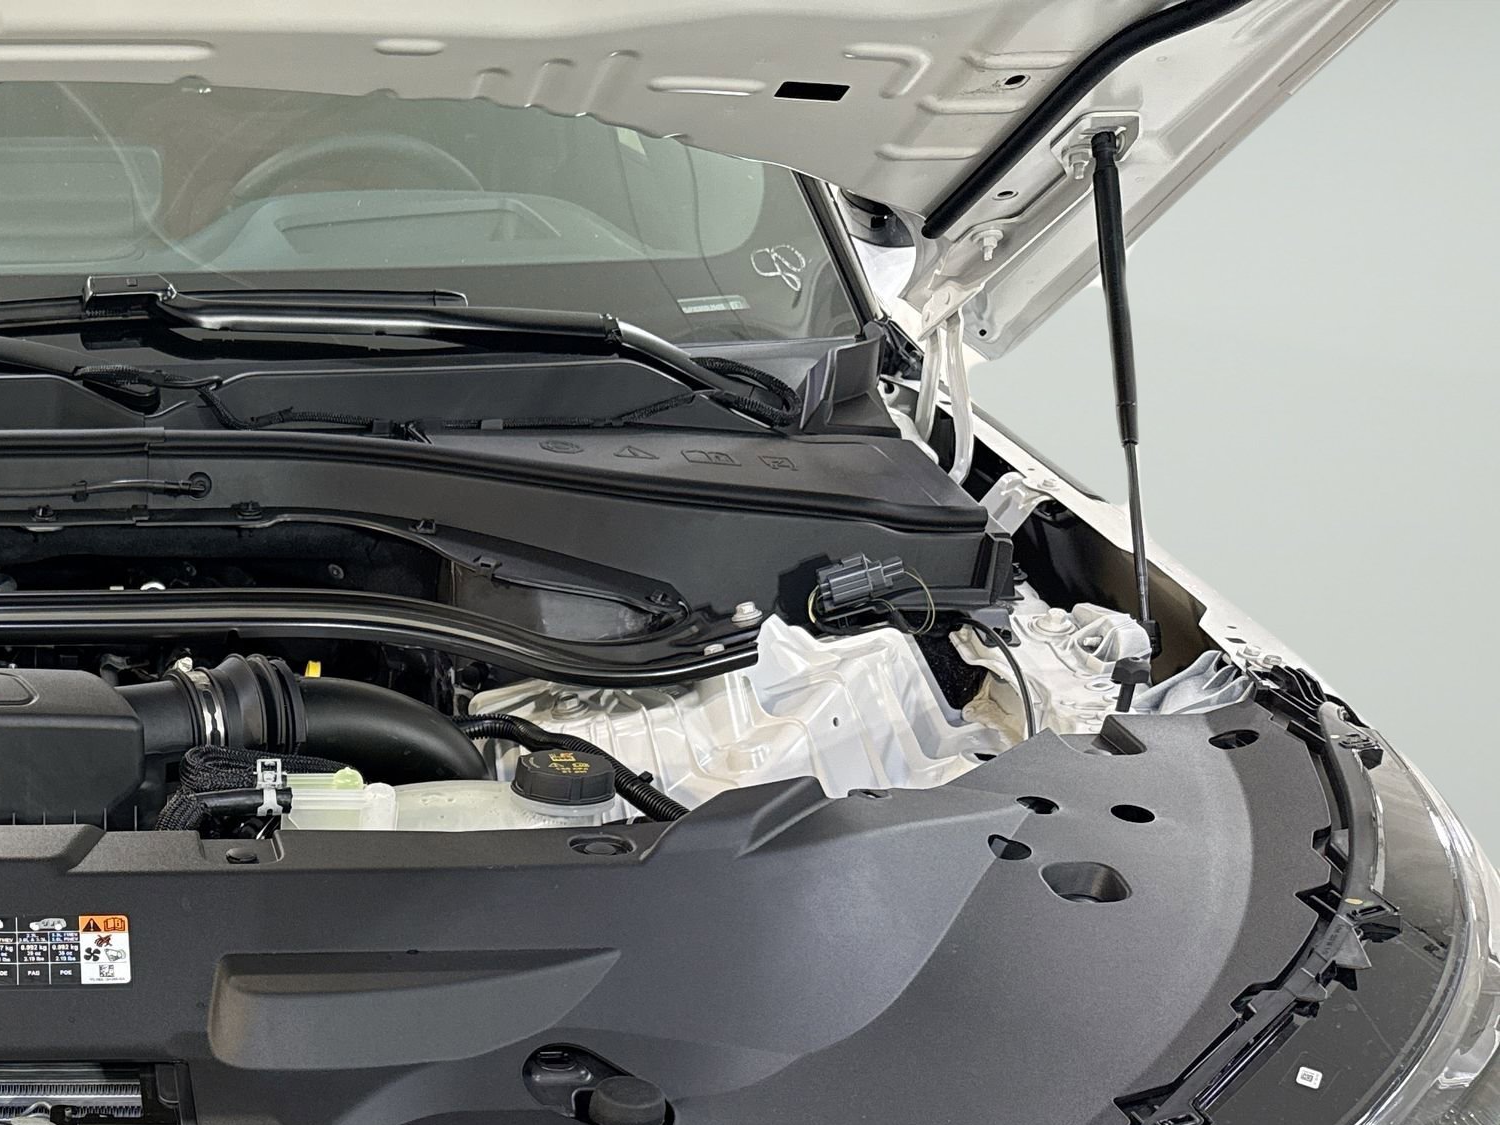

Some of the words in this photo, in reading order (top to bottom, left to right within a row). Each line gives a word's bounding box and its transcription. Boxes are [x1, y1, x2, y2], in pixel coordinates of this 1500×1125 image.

[5, 945, 14, 953] kg
[38, 944, 48, 952] kg
[70, 943, 79, 952] kg
